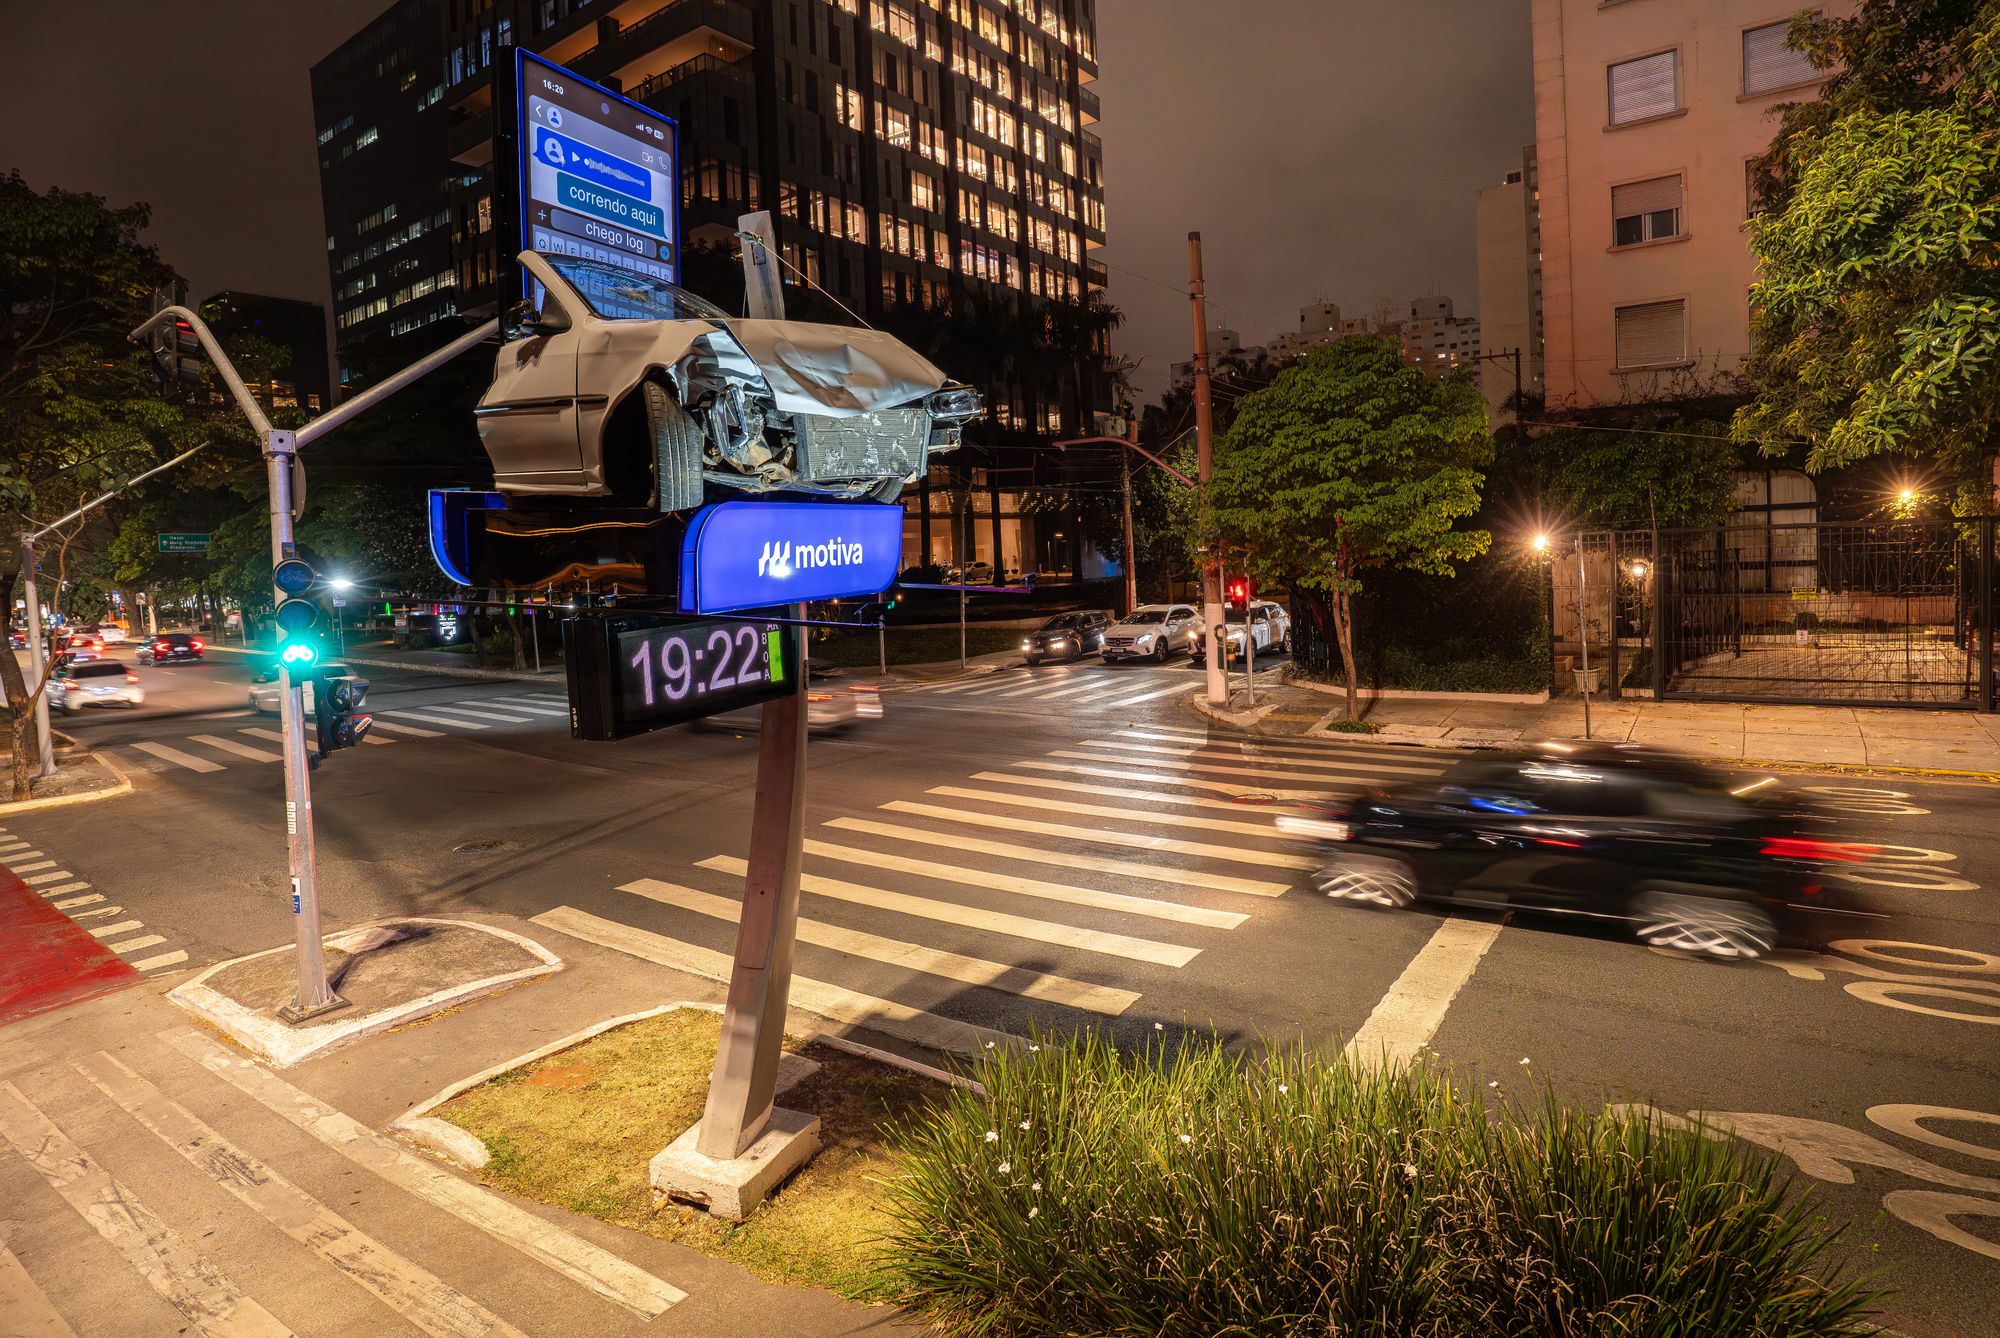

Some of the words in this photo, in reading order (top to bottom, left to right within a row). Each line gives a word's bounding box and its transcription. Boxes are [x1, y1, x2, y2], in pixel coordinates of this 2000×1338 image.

[542, 78, 564, 95] 16:20
[569, 185, 628, 216] correndo
[631, 206, 657, 227] aqui
[539, 238, 547, 250] Q
[553, 242, 563, 254] W
[585, 221, 624, 245] chego
[626, 231, 644, 254] log
[795, 536, 863, 569] motiva
[631, 625, 762, 705] 19:22
